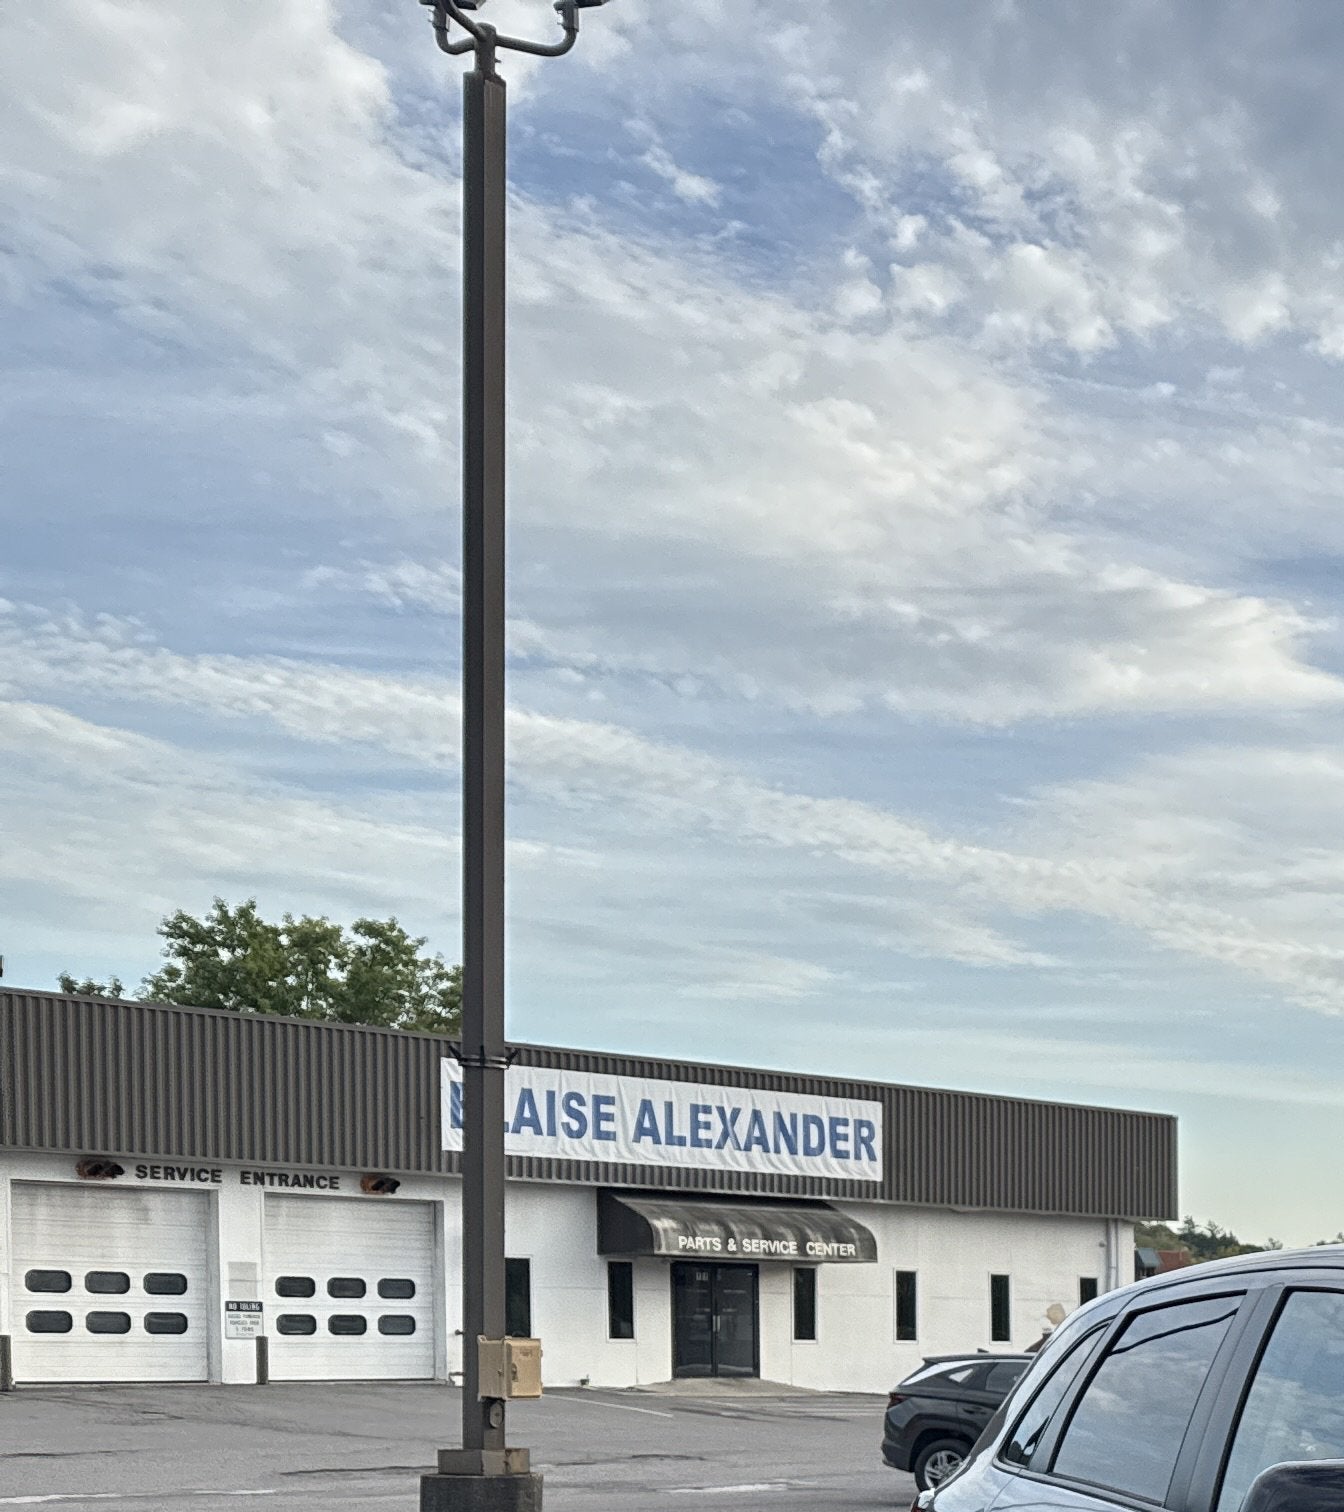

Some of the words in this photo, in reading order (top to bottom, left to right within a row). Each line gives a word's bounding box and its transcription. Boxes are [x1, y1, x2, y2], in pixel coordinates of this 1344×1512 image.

[450, 1080, 617, 1143] AISE
[631, 1097, 878, 1163] ALEXANDER
[135, 1164, 223, 1184] SERVICE
[240, 1170, 340, 1190] ENTRANCE
[678, 1235, 722, 1251] PARTS
[727, 1237, 737, 1252] &
[742, 1238, 798, 1255] SERVICE
[806, 1241, 856, 1257] CENTER
